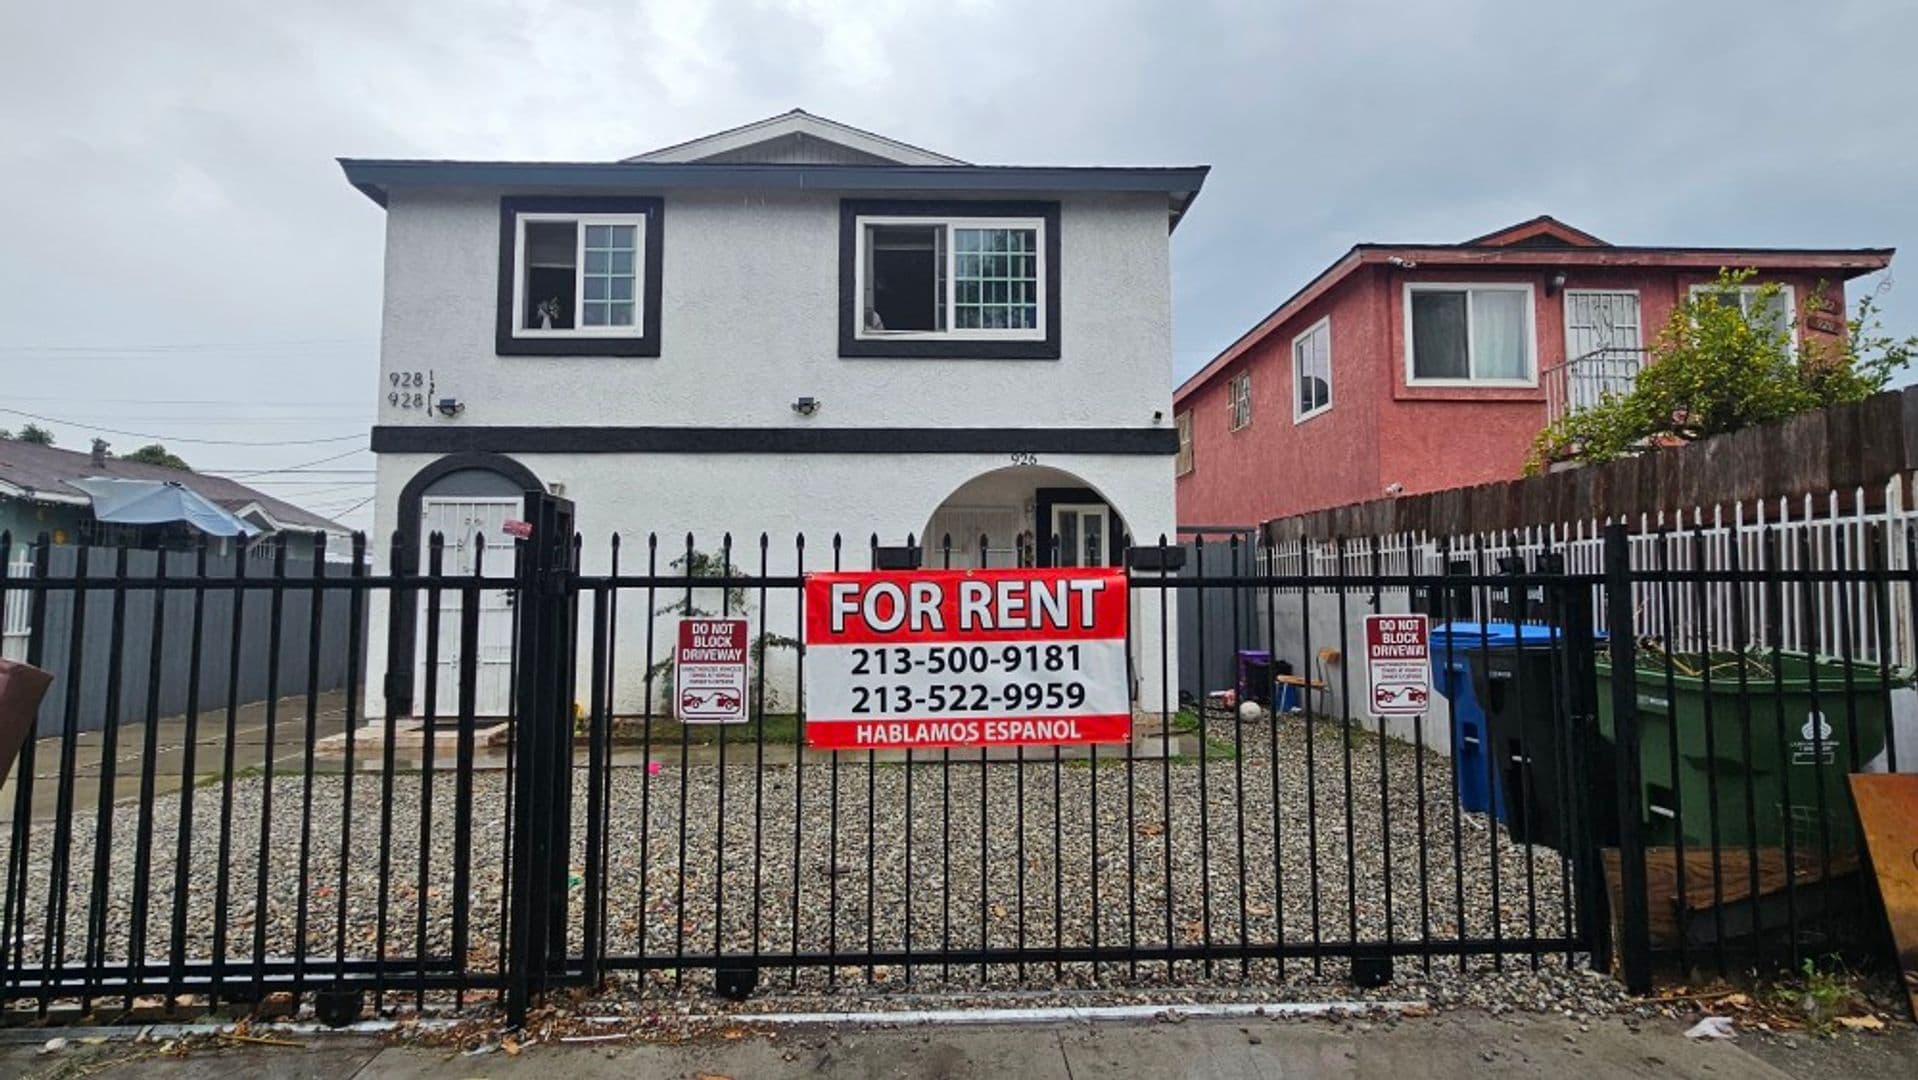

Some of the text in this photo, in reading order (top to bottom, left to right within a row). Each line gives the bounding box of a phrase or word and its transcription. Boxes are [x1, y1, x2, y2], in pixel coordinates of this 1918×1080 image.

[389, 371, 424, 388] 928
[387, 391, 424, 408] 928
[1010, 453, 1037, 466] 926
[831, 577, 1105, 633] FOR RENT
[692, 622, 735, 635] DO NOT
[1379, 619, 1420, 631] DO NOT
[693, 635, 733, 648] BLOCK
[1382, 632, 1420, 644] BLOCK
[682, 648, 743, 661] DRIVEWAY
[850, 643, 1081, 675] 213-500-9181
[850, 681, 1086, 714] 213-522-9959
[856, 719, 1082, 744] HABLAMOS ESPANOL
